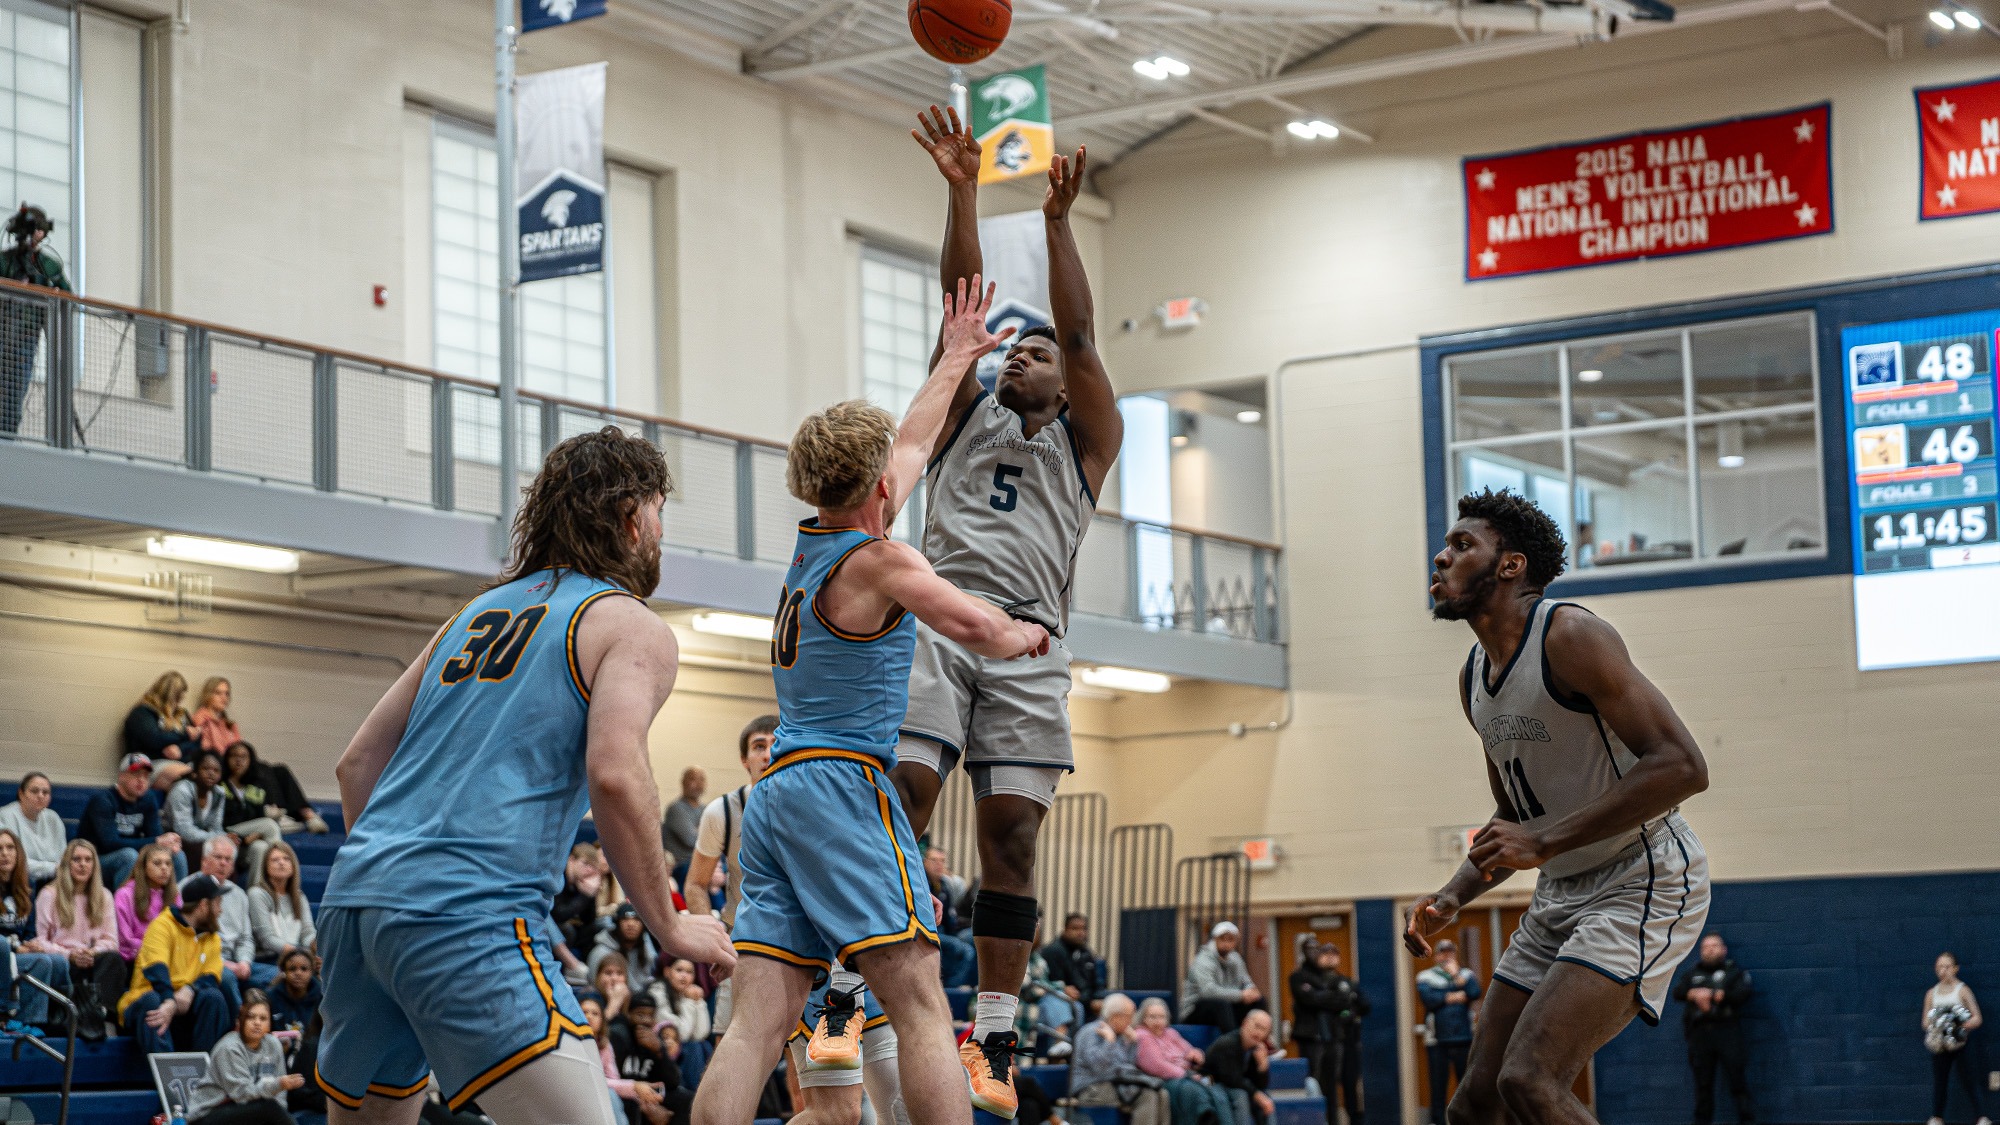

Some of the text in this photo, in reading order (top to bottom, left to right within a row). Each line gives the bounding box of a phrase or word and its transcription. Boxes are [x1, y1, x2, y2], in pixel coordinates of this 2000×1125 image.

[1575, 135, 1708, 178] 2015 NAIA
[1516, 152, 1773, 212] MEN'S VOLLEYBALL
[1487, 175, 1799, 244] NATIONAL INVITATIONAL
[521, 222, 602, 254] SPARTANS
[1579, 215, 1709, 259] CHAMPION
[1917, 342, 1975, 382] 48
[1866, 392, 1974, 420] FOULS 1
[1921, 424, 1980, 465] 46
[989, 462, 1024, 513] 5
[1870, 474, 1979, 502] FOULS 3
[1873, 505, 1988, 552] 11:45
[1962, 548, 1971, 561] 2
[439, 603, 550, 686] 30
[1504, 757, 1546, 821] 11
